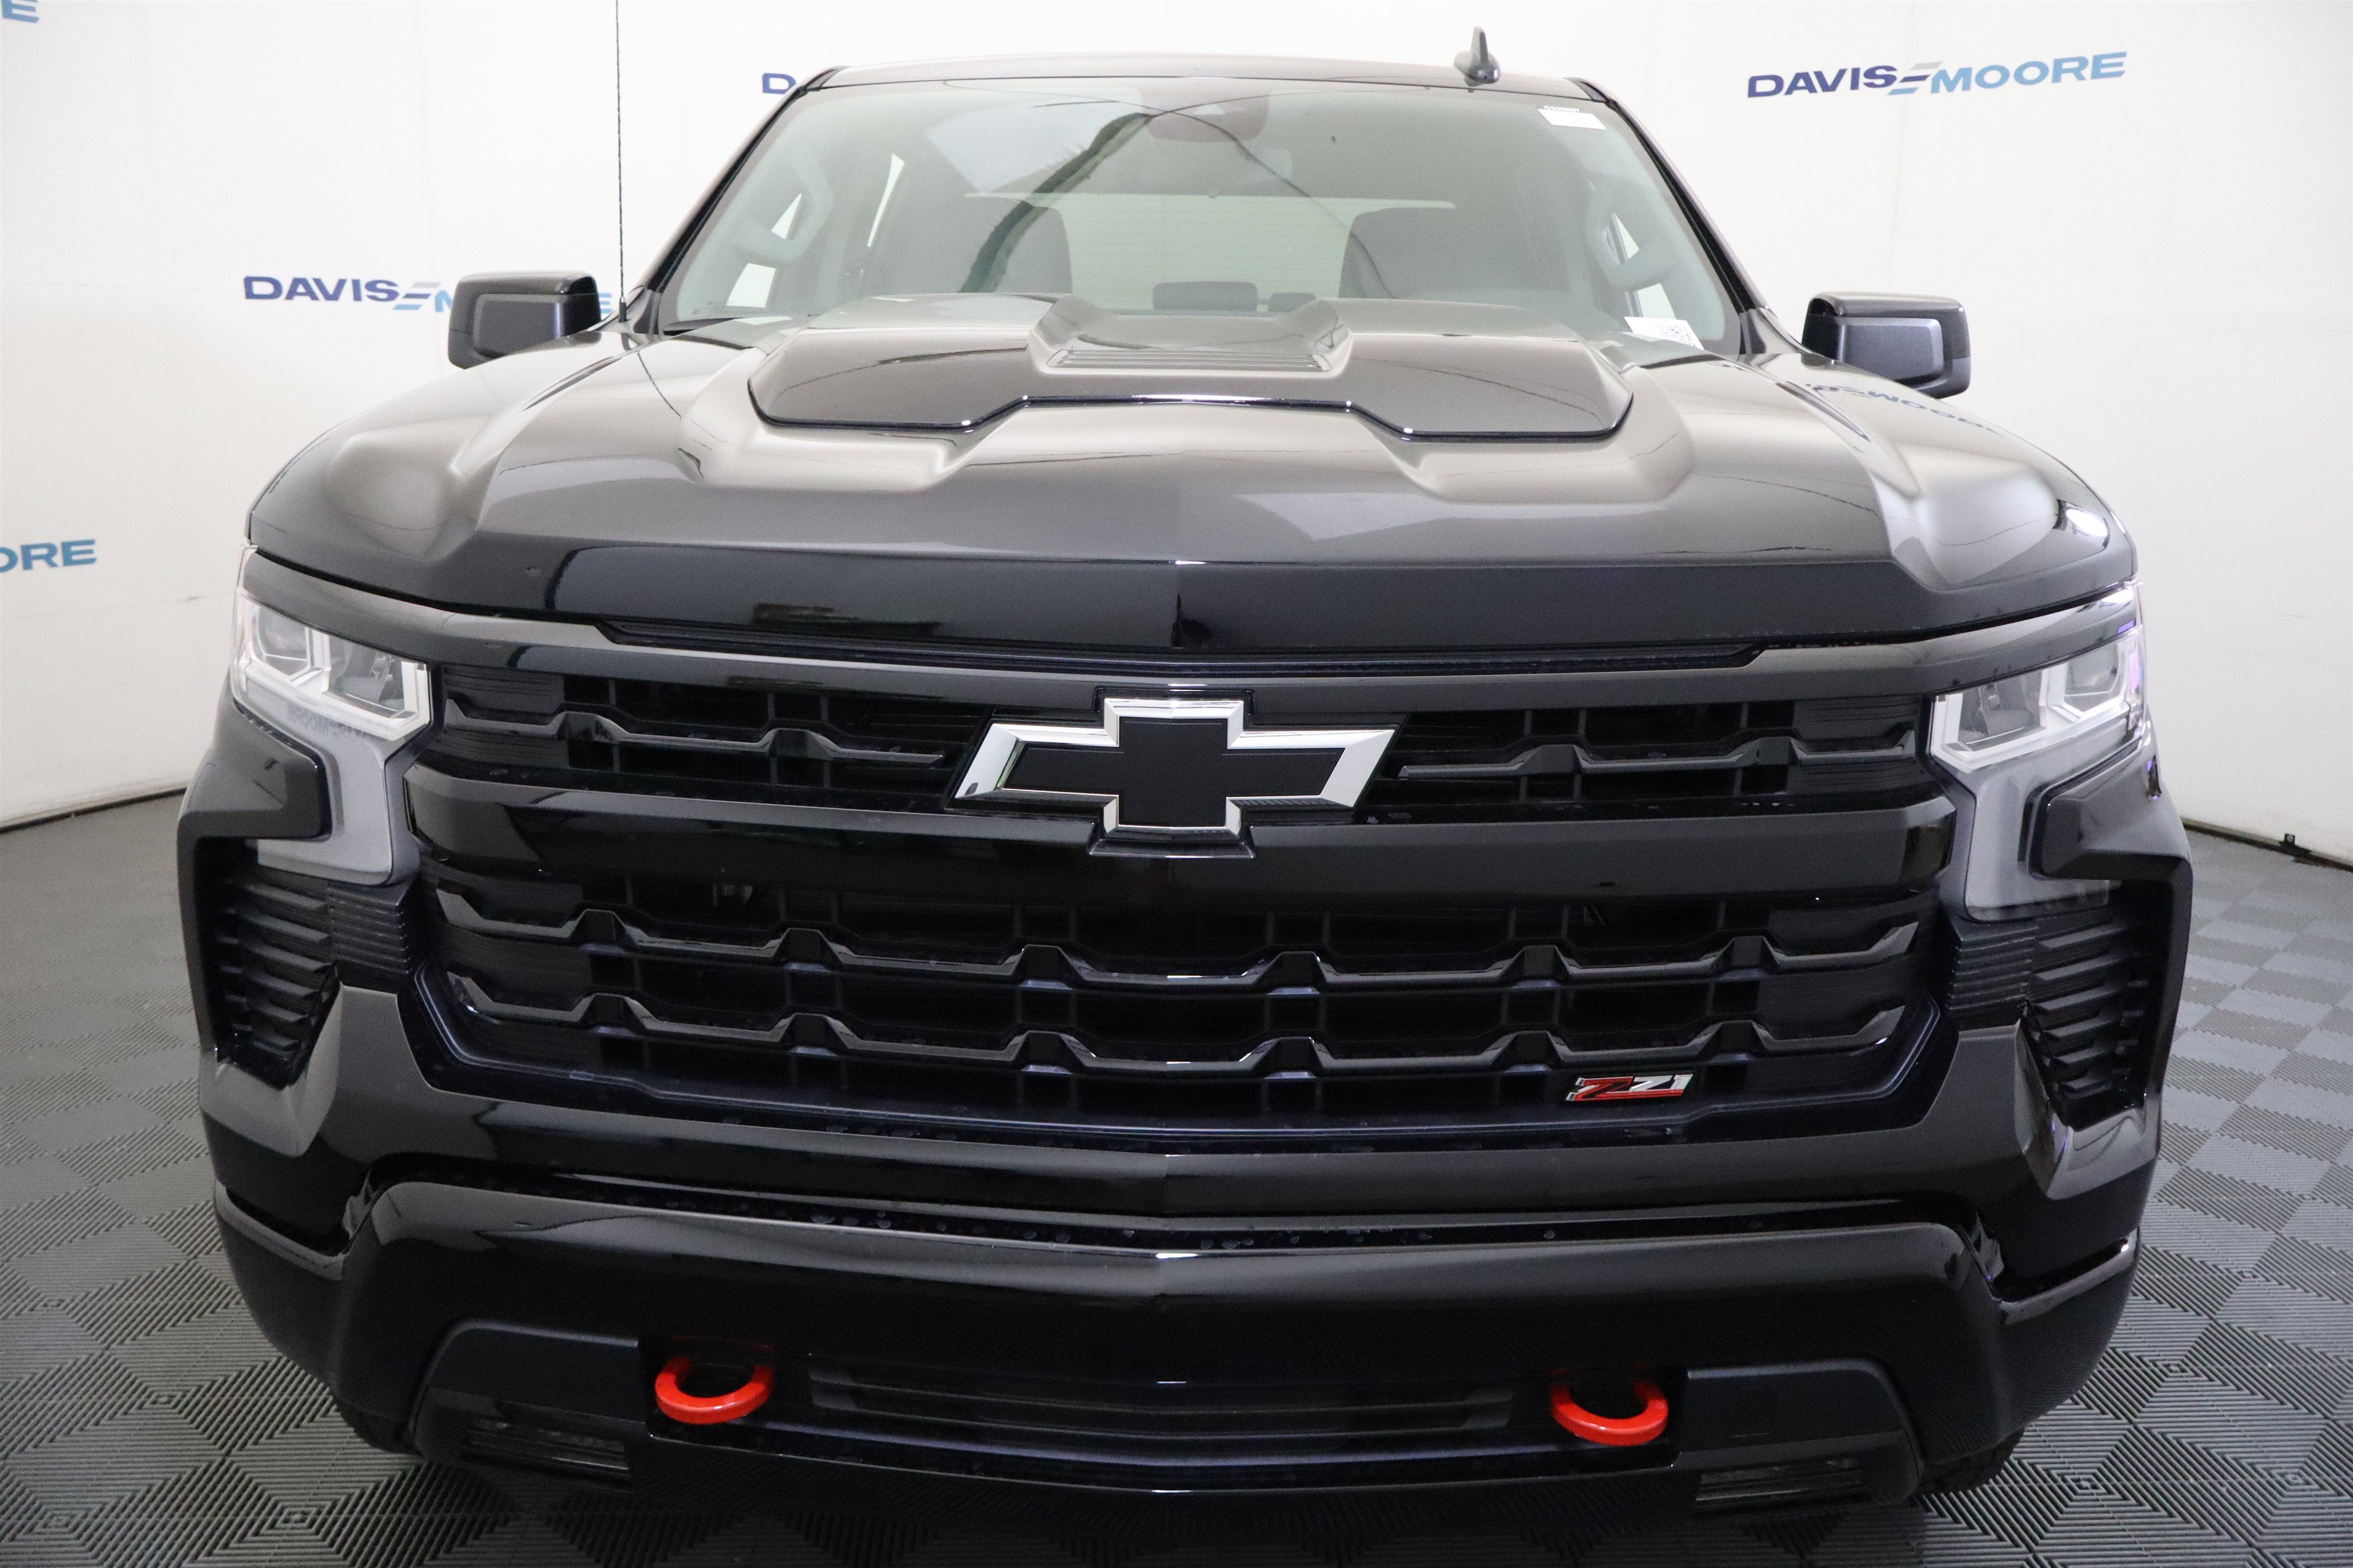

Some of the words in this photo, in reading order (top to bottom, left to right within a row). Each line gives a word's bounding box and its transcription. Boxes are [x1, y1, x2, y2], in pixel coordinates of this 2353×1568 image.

[1748, 65, 1897, 97] DAVIS
[1931, 52, 2127, 93] MOORE
[244, 276, 399, 302] DAVIS
[1566, 1074, 1694, 1101] Z71
